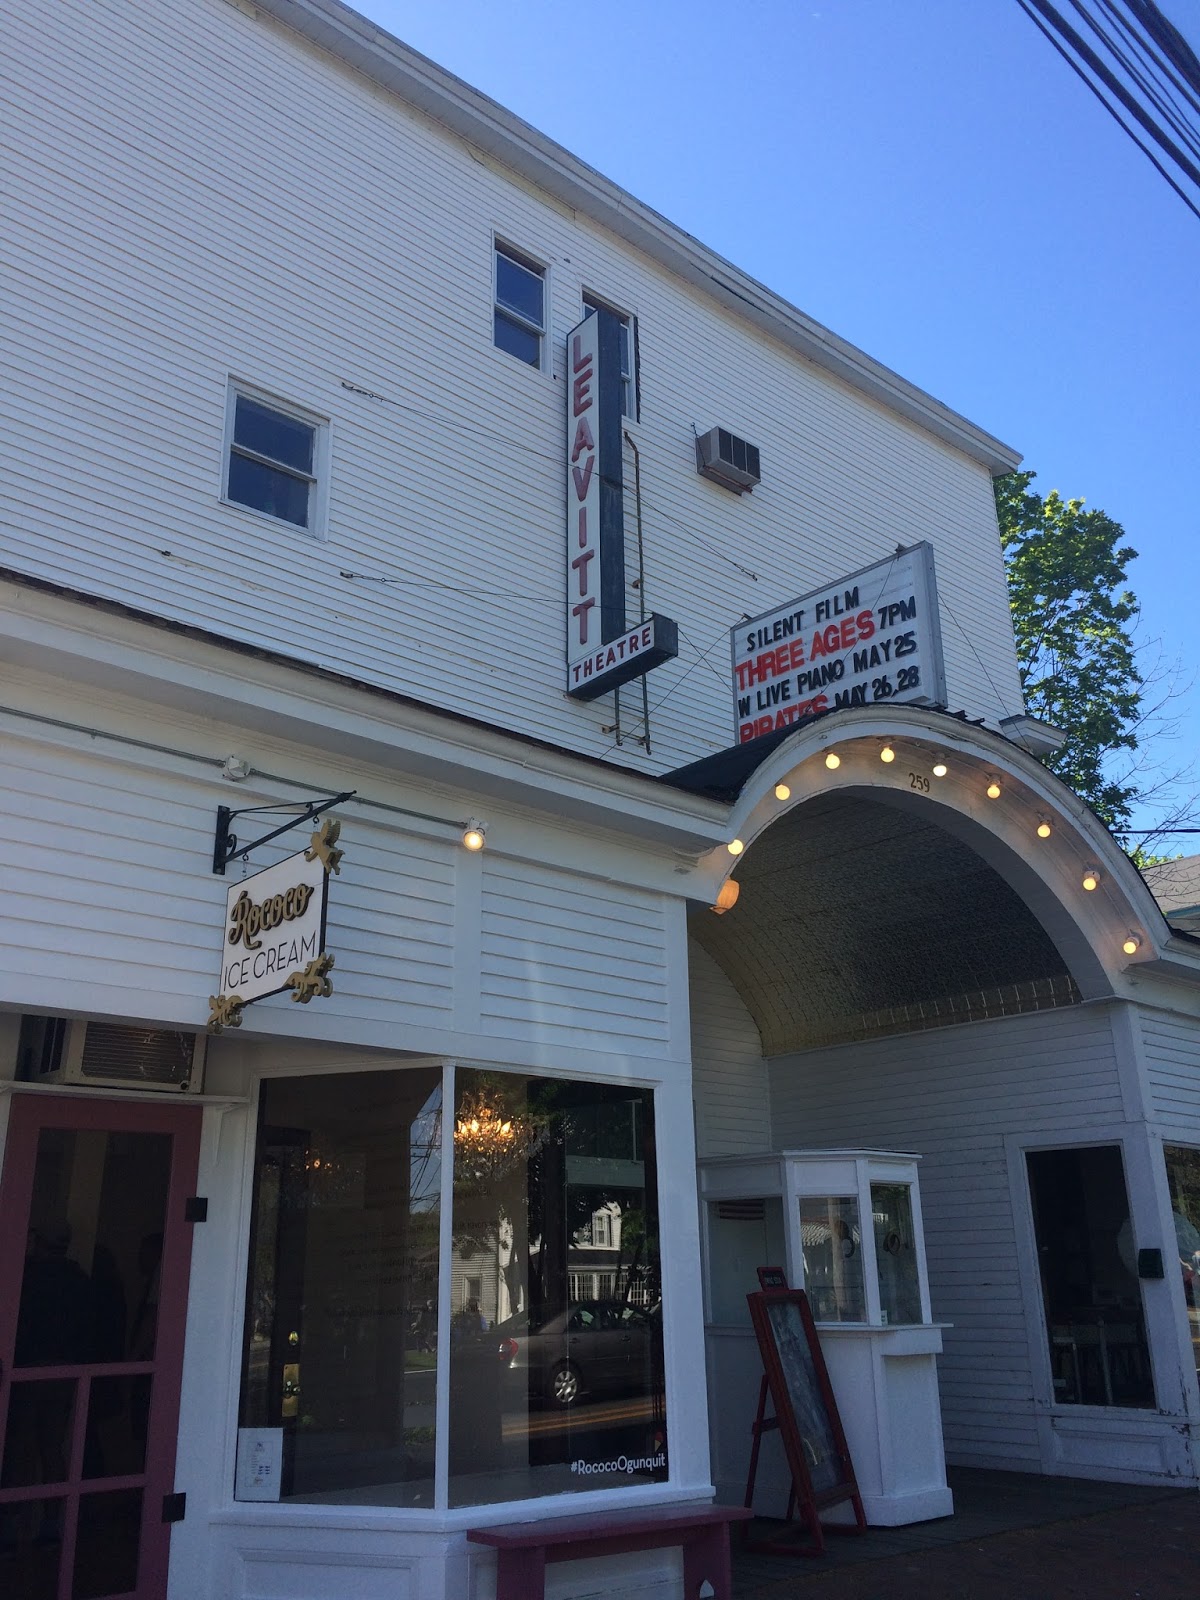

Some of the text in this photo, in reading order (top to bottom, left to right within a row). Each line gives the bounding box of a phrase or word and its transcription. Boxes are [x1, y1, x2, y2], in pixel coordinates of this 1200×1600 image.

[572, 334, 595, 646] LEAVITT
[735, 595, 917, 691] THREE AGES 7PM
[746, 586, 860, 652] SILENT FILM
[573, 624, 652, 684] THEATRE
[738, 630, 918, 719] W LIVE PIANO MAY 25
[834, 682, 868, 708] MAY
[908, 772, 930, 793] 259
[228, 883, 315, 951] Rococo
[223, 929, 317, 992] ICE CREAM
[570, 1453, 666, 1475] #RococoOgunquit
